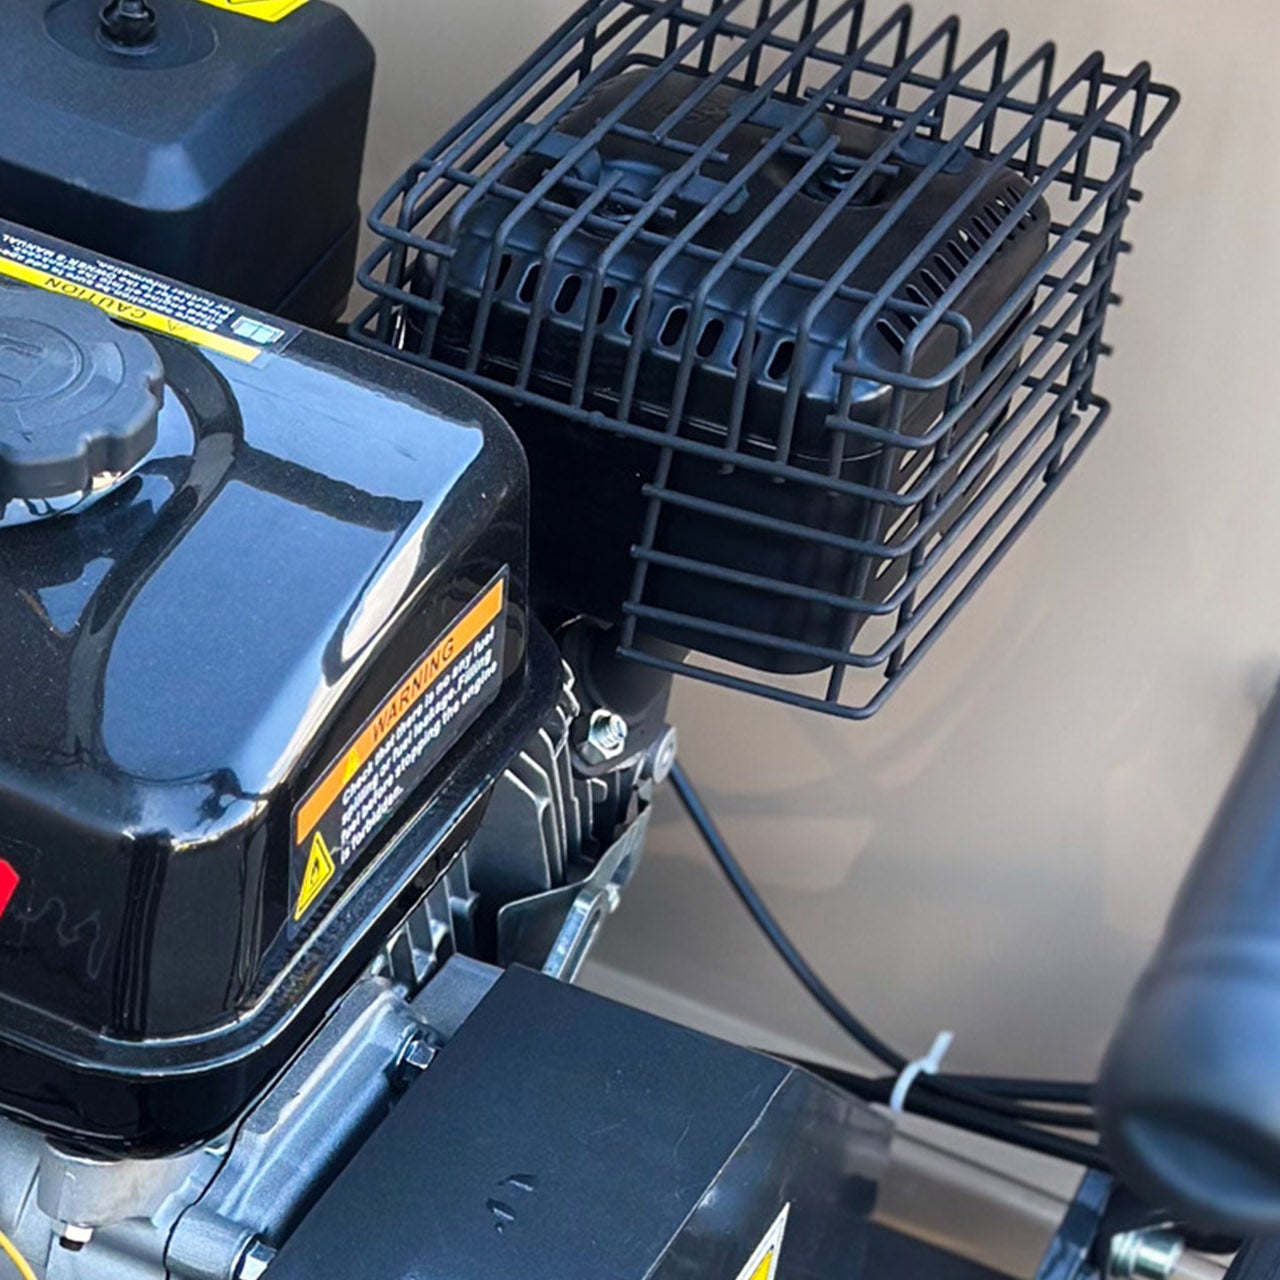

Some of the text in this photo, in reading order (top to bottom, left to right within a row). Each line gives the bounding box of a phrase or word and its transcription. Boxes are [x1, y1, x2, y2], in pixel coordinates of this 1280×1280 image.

[0, 233, 56, 257] MANUAL
[45, 278, 147, 320] CAUTION
[342, 625, 495, 806] Check that there is no any fuel
[371, 637, 455, 743] WARNING
[340, 661, 498, 845] fuel before stopping the engine
[379, 757, 392, 777] or
[393, 730, 413, 763] fuel
